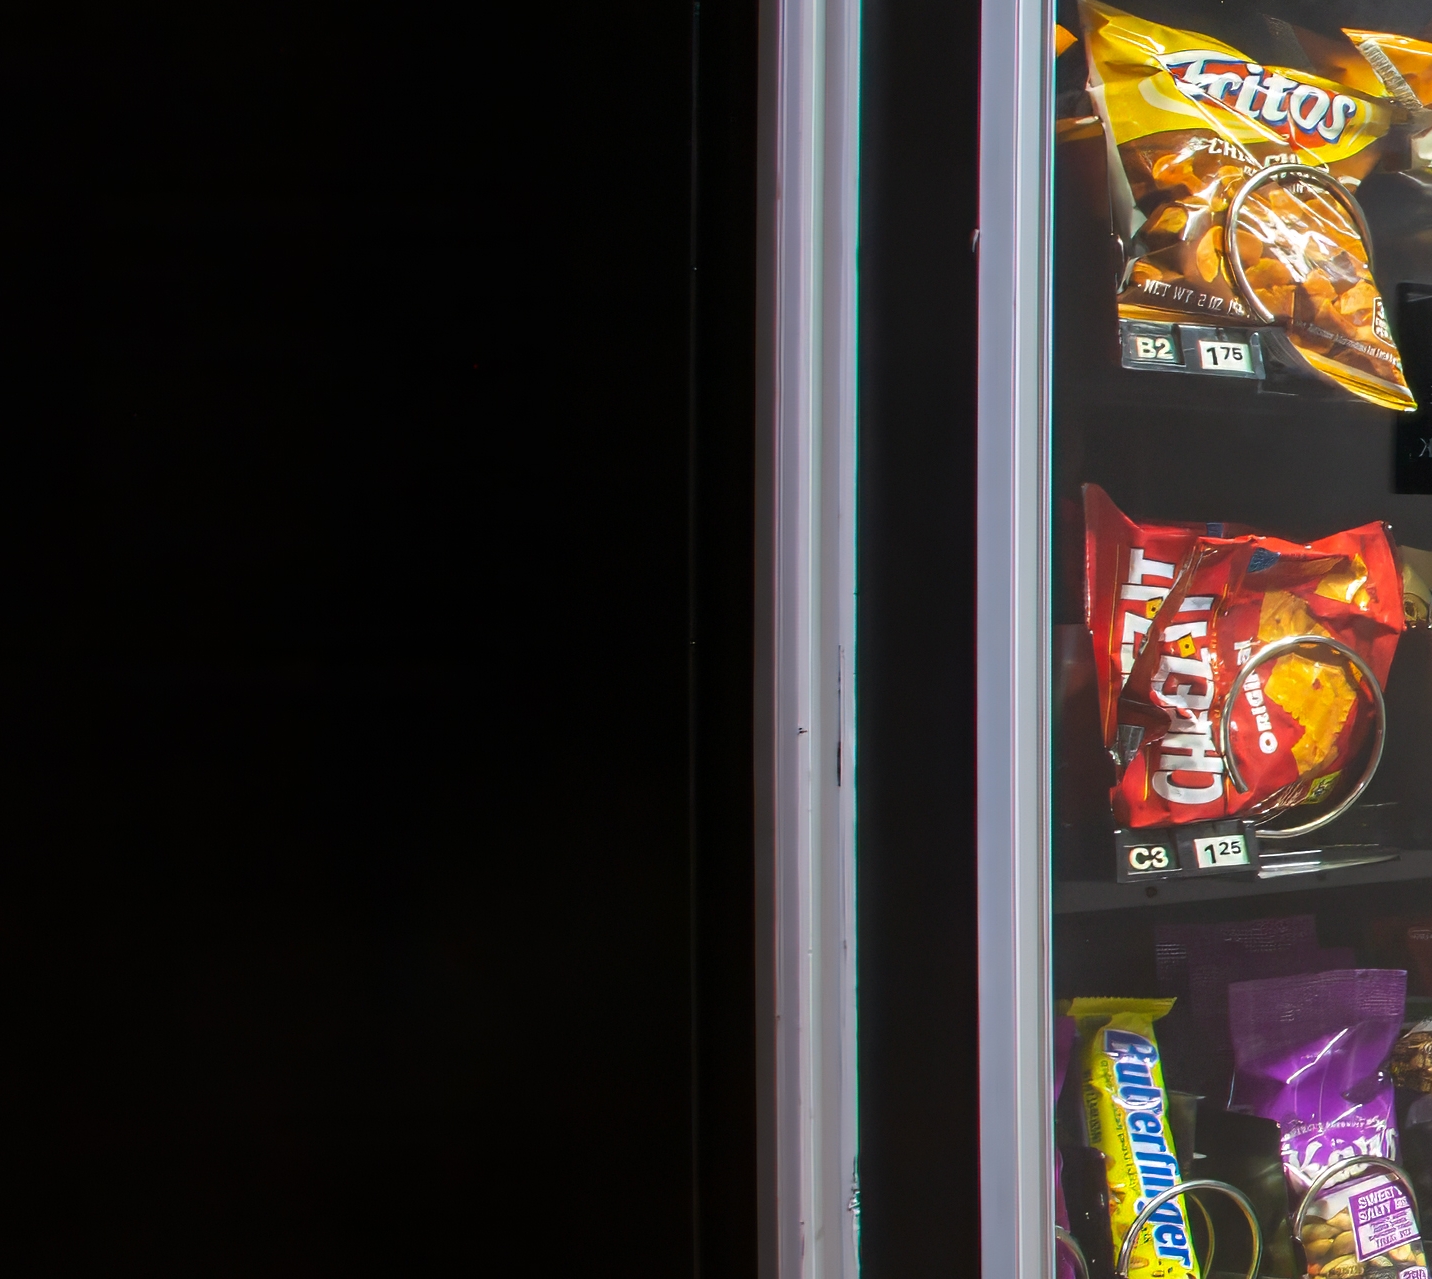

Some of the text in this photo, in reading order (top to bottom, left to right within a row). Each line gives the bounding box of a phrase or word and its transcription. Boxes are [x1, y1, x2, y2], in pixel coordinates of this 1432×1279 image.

[1168, 58, 1357, 144] Fritos
[1136, 336, 1244, 367] B2 175
[1129, 840, 1242, 871] C3 125
